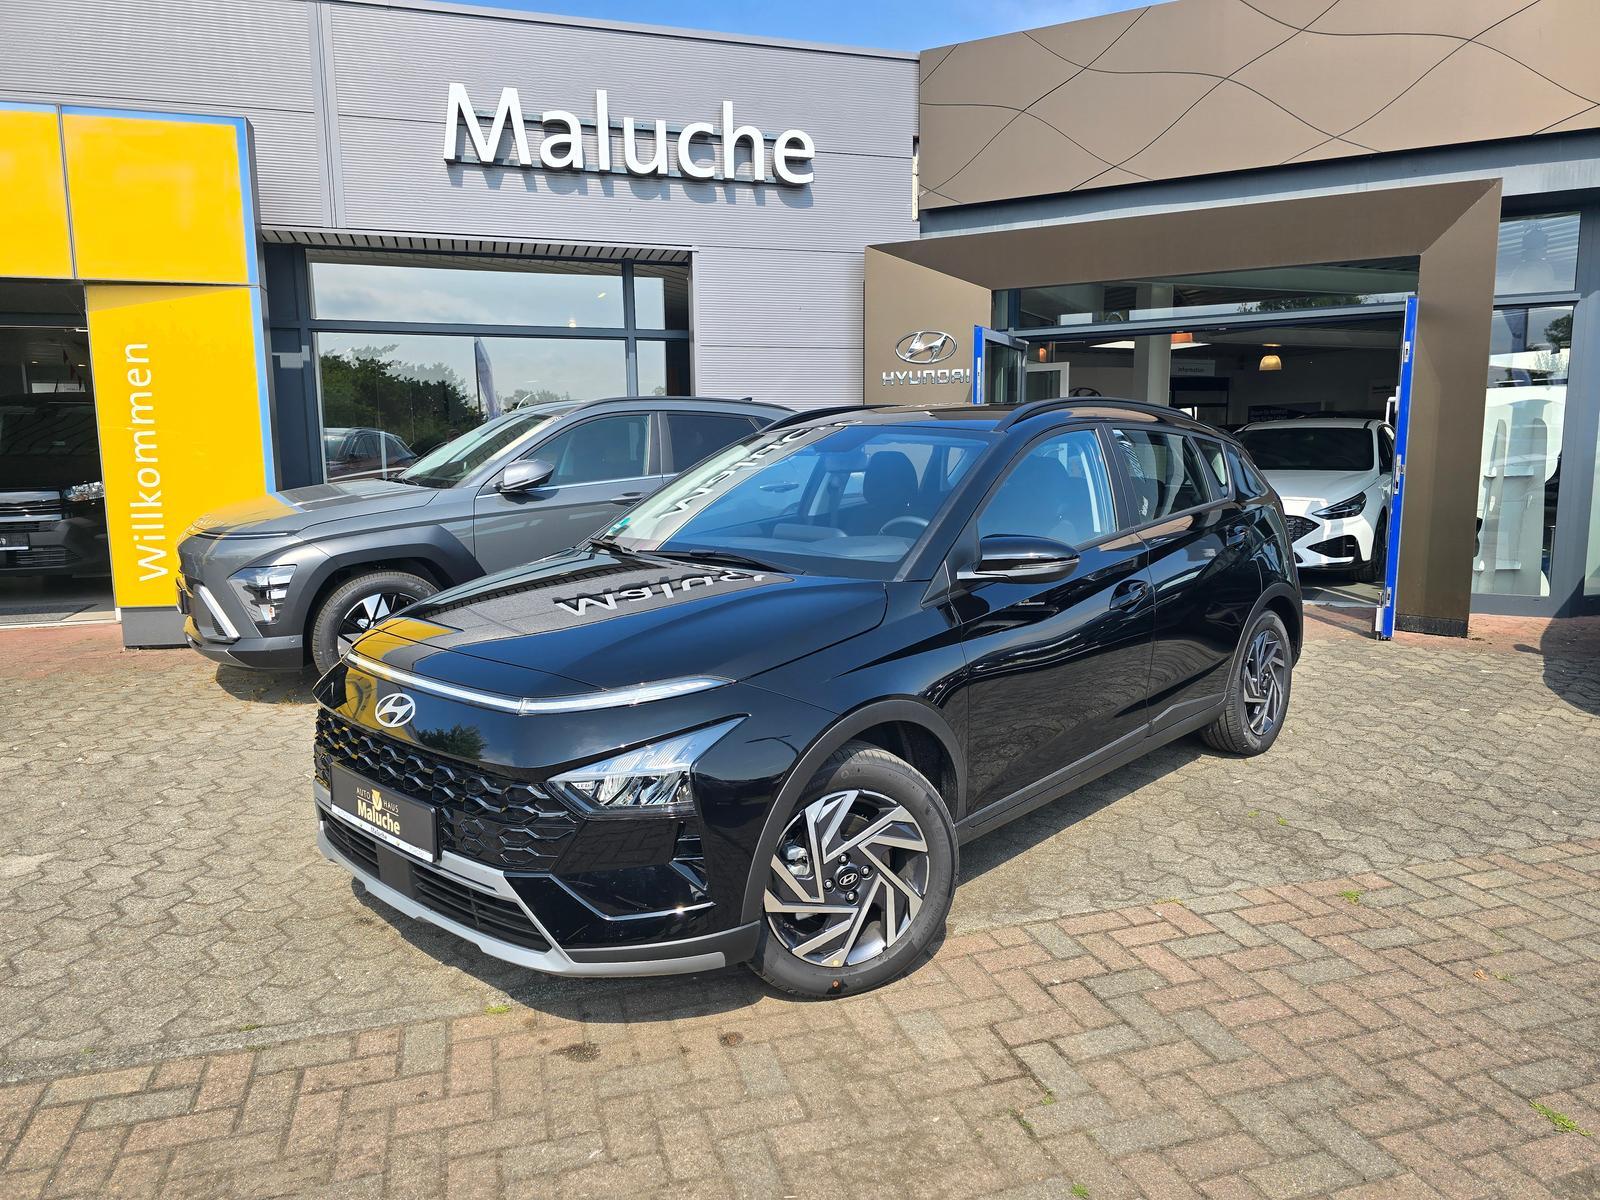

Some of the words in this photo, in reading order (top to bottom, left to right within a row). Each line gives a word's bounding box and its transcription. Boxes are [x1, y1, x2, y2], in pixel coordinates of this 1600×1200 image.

[443, 82, 816, 185] Maluche
[882, 368, 970, 386] HYUNDAI
[124, 343, 169, 582] Willkommen
[356, 787, 371, 799] AUTO
[383, 800, 399, 813] HAUS
[357, 799, 400, 835] Maluche
